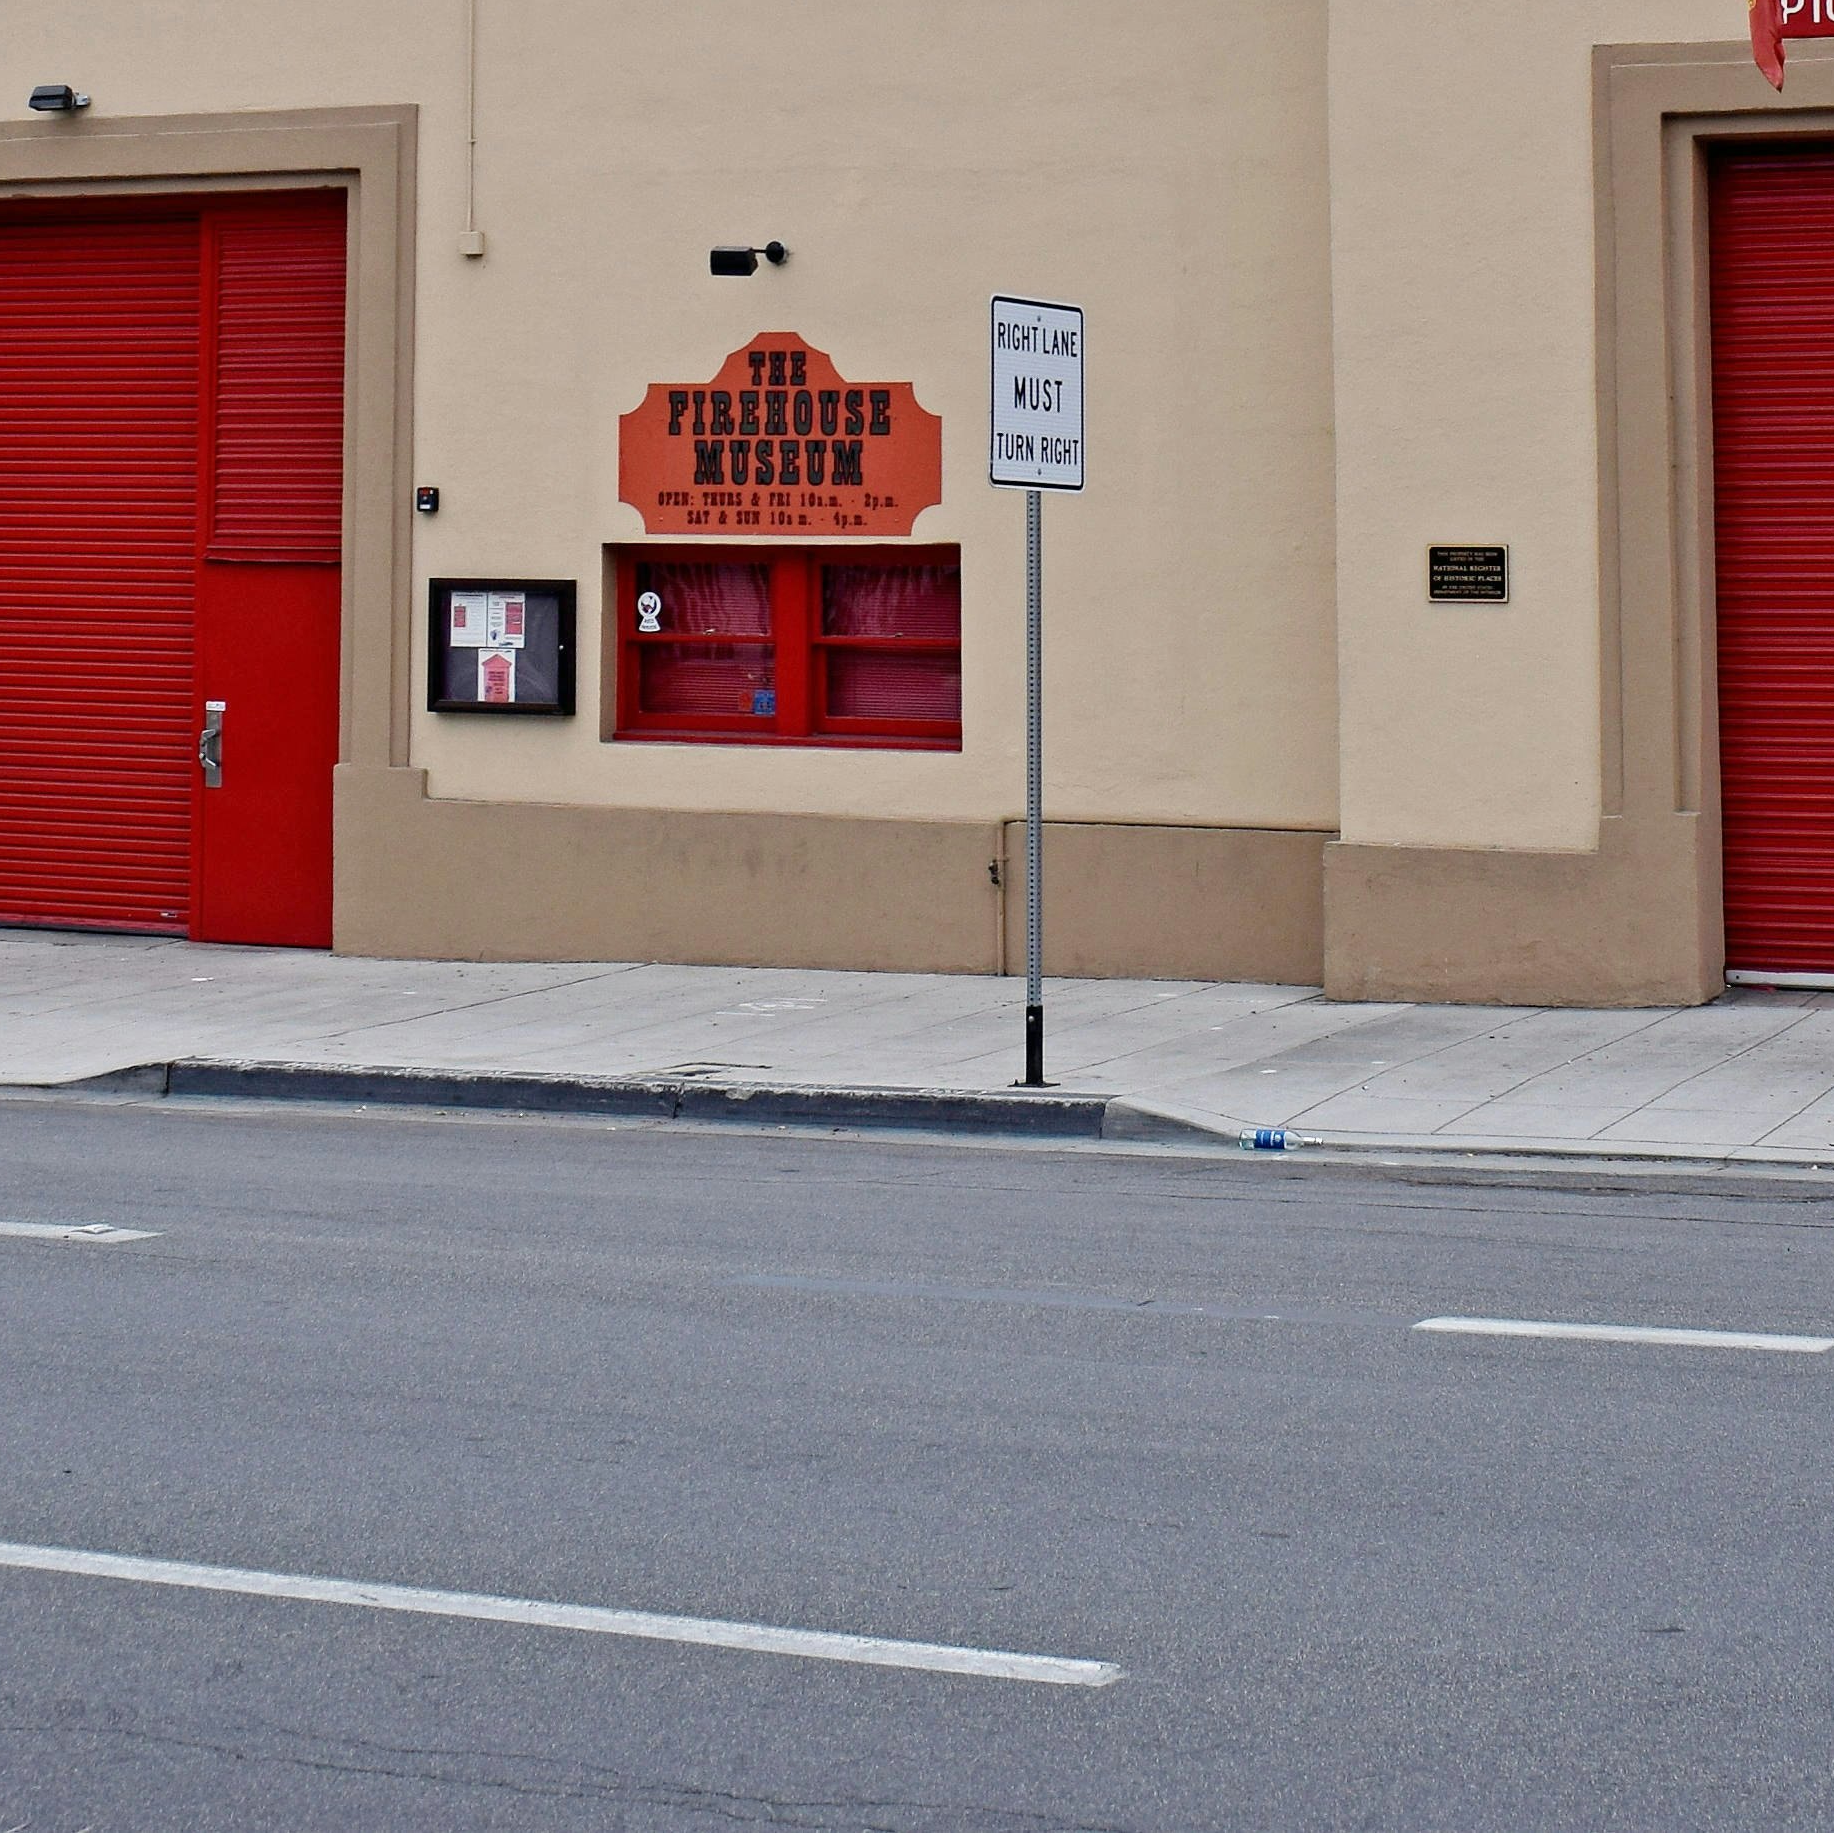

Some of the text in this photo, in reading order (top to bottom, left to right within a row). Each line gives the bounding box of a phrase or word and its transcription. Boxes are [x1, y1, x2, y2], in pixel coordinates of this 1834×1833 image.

[998, 322, 1078, 358] RIGHT LANE
[748, 351, 806, 386] THE
[1014, 376, 1063, 413] MUST
[668, 389, 891, 436] FIREHOUSE
[693, 439, 864, 486] MUSEUM
[997, 432, 1079, 466] TURN RIGHT
[658, 492, 695, 507] OPEN:
[702, 492, 743, 507] THURS
[751, 493, 760, 507] &
[769, 493, 791, 507] FRI
[864, 493, 900, 510] 2p.m.
[687, 510, 711, 525] SAT
[718, 511, 728, 525] &
[736, 511, 760, 525] SUN
